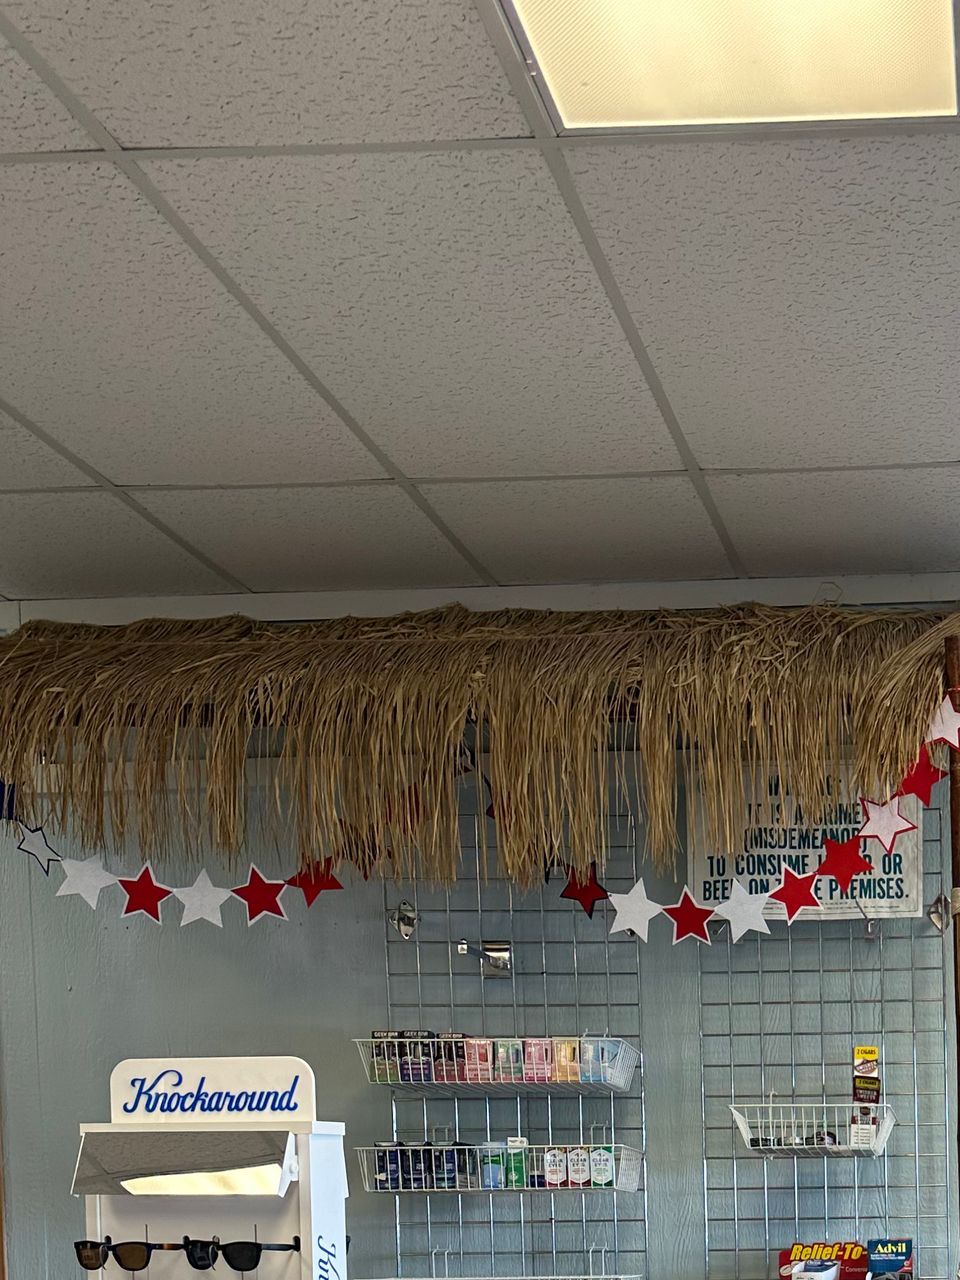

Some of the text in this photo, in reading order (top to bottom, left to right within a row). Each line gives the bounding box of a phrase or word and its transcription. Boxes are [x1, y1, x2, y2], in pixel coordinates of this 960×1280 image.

[707, 855, 725, 877] TO
[735, 855, 809, 877] CONSUME
[882, 853, 902, 875] OR
[703, 879, 735, 902] BEE
[749, 878, 770, 899] ON
[123, 1069, 300, 1114] Knockaround
[875, 1243, 907, 1254] Advil
